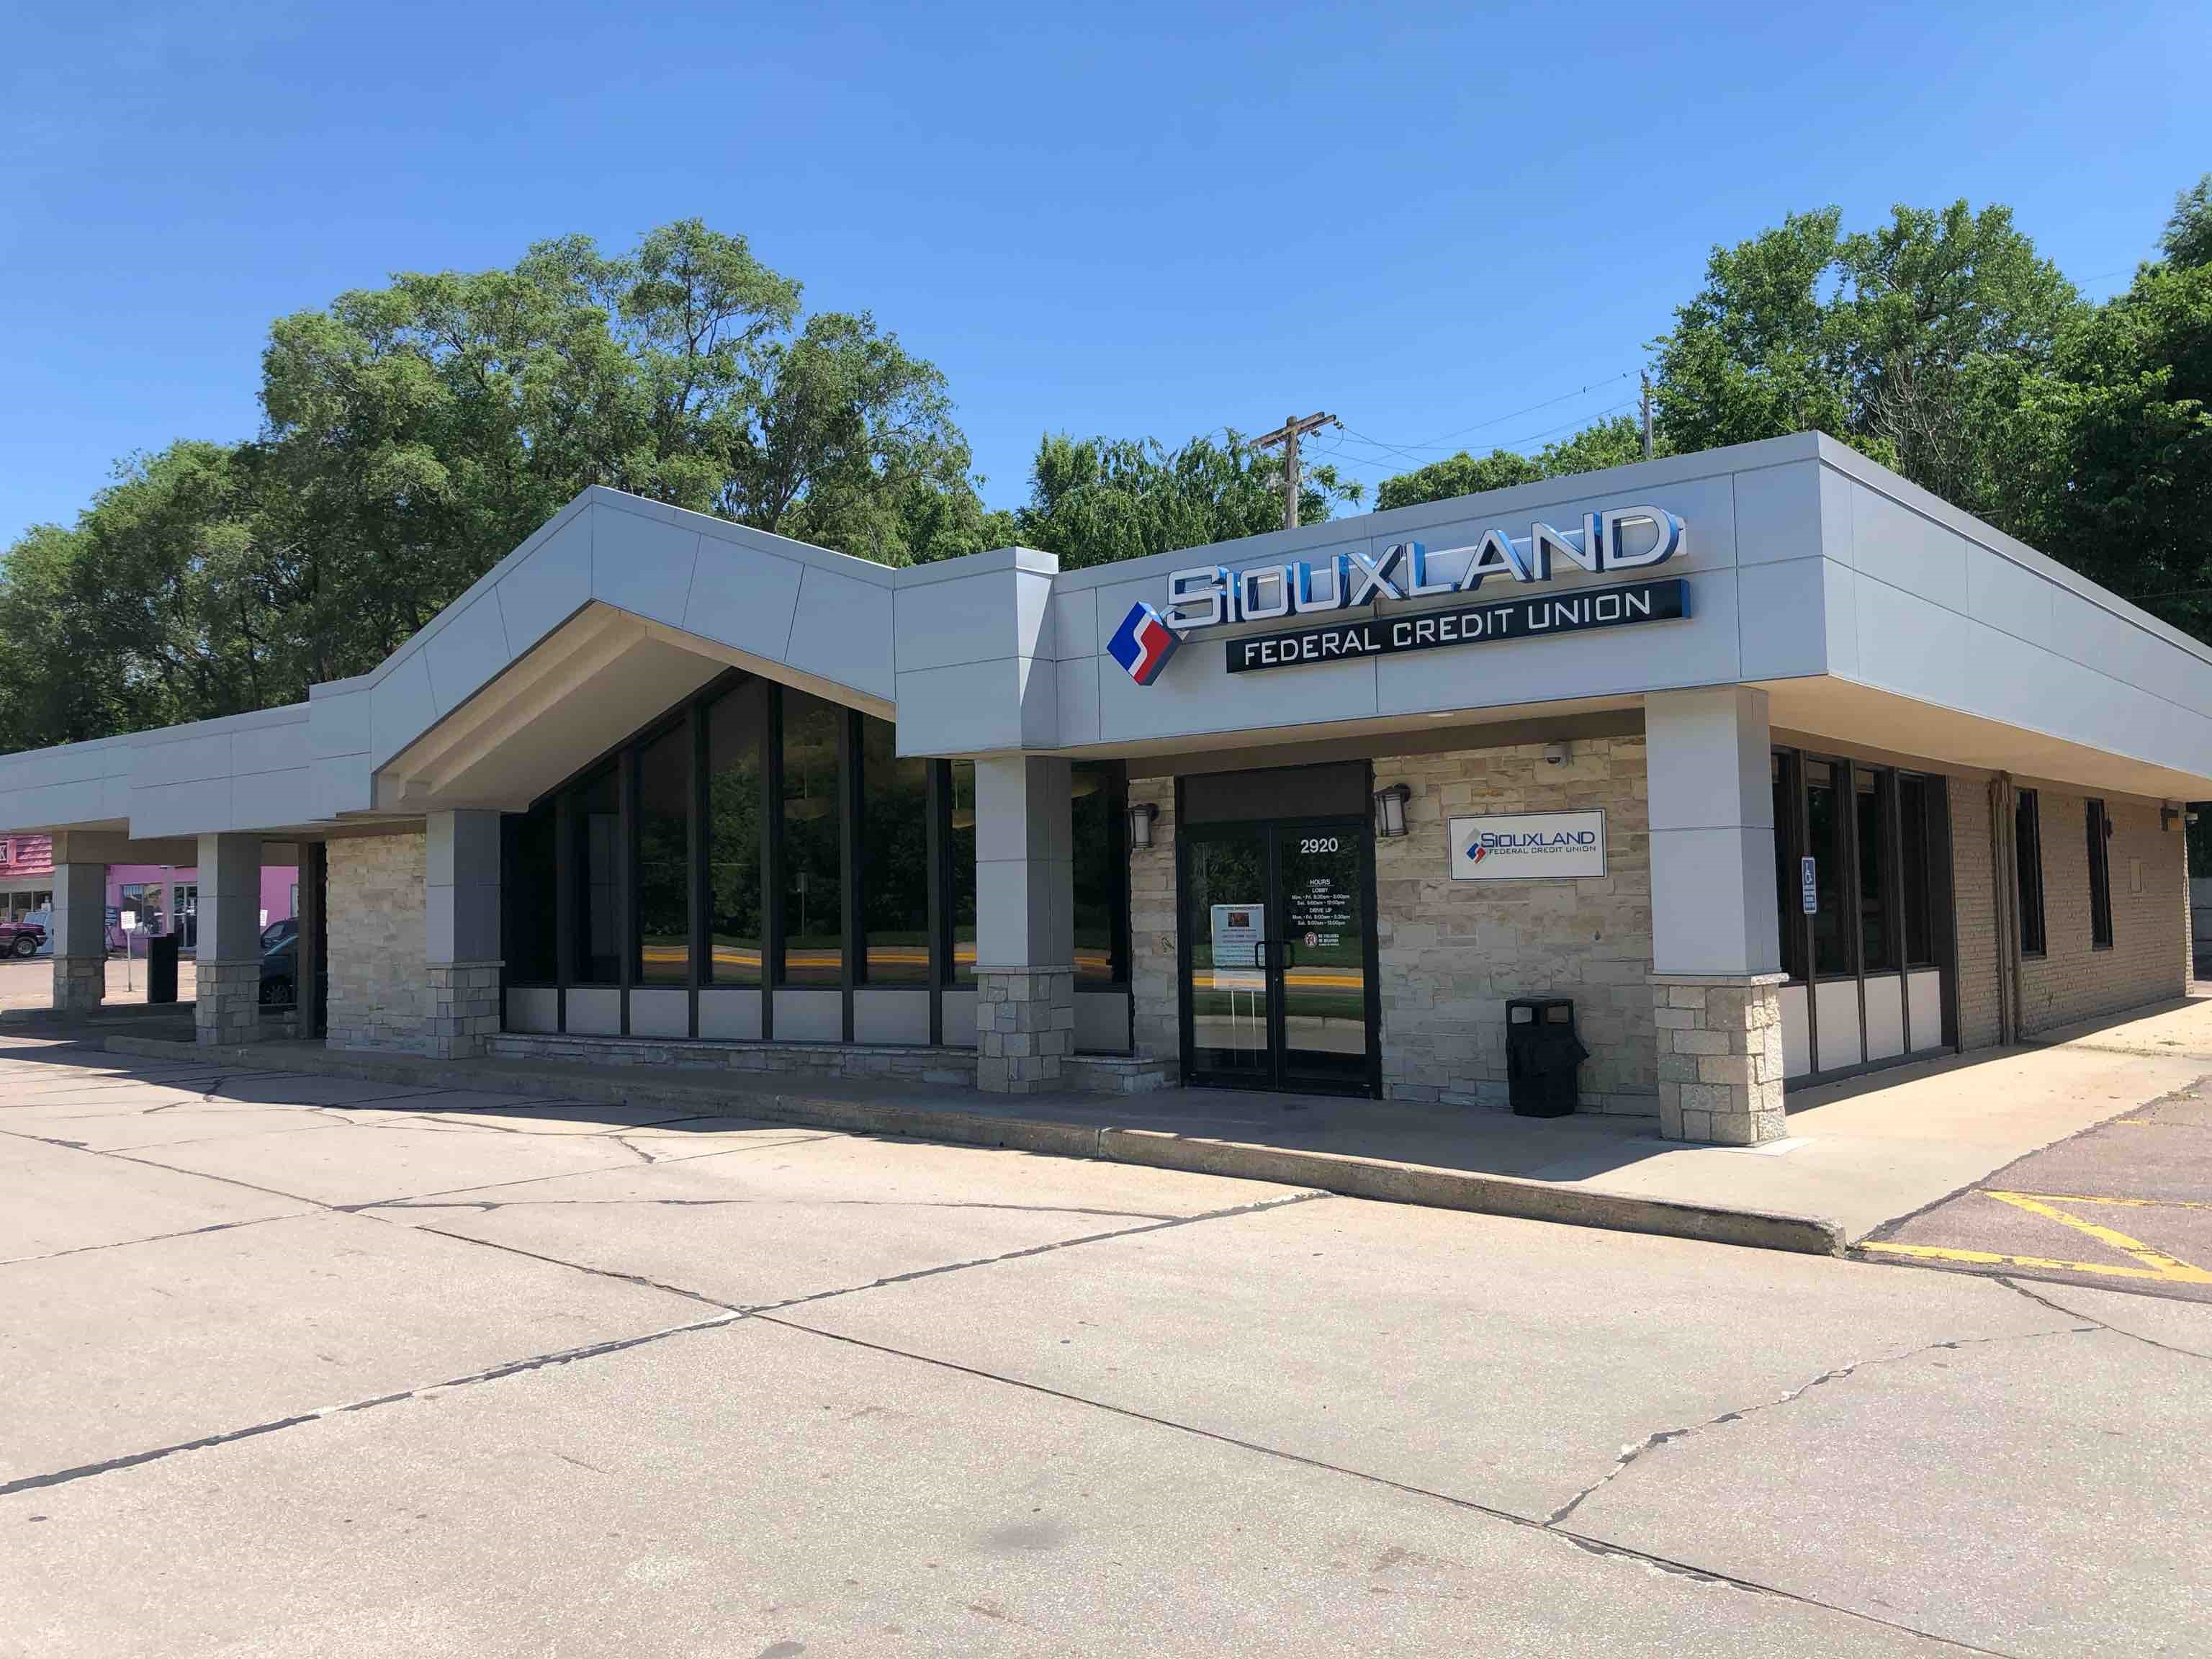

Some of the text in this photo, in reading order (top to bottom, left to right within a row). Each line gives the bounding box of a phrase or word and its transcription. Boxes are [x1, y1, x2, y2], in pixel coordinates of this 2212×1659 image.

[1166, 504, 1681, 629] SIOUXLAND
[1244, 589, 1651, 666] FEDERAL CREDIT UNION
[1300, 837, 1339, 853] 2920
[1480, 830, 1596, 848] SIOUXLAND
